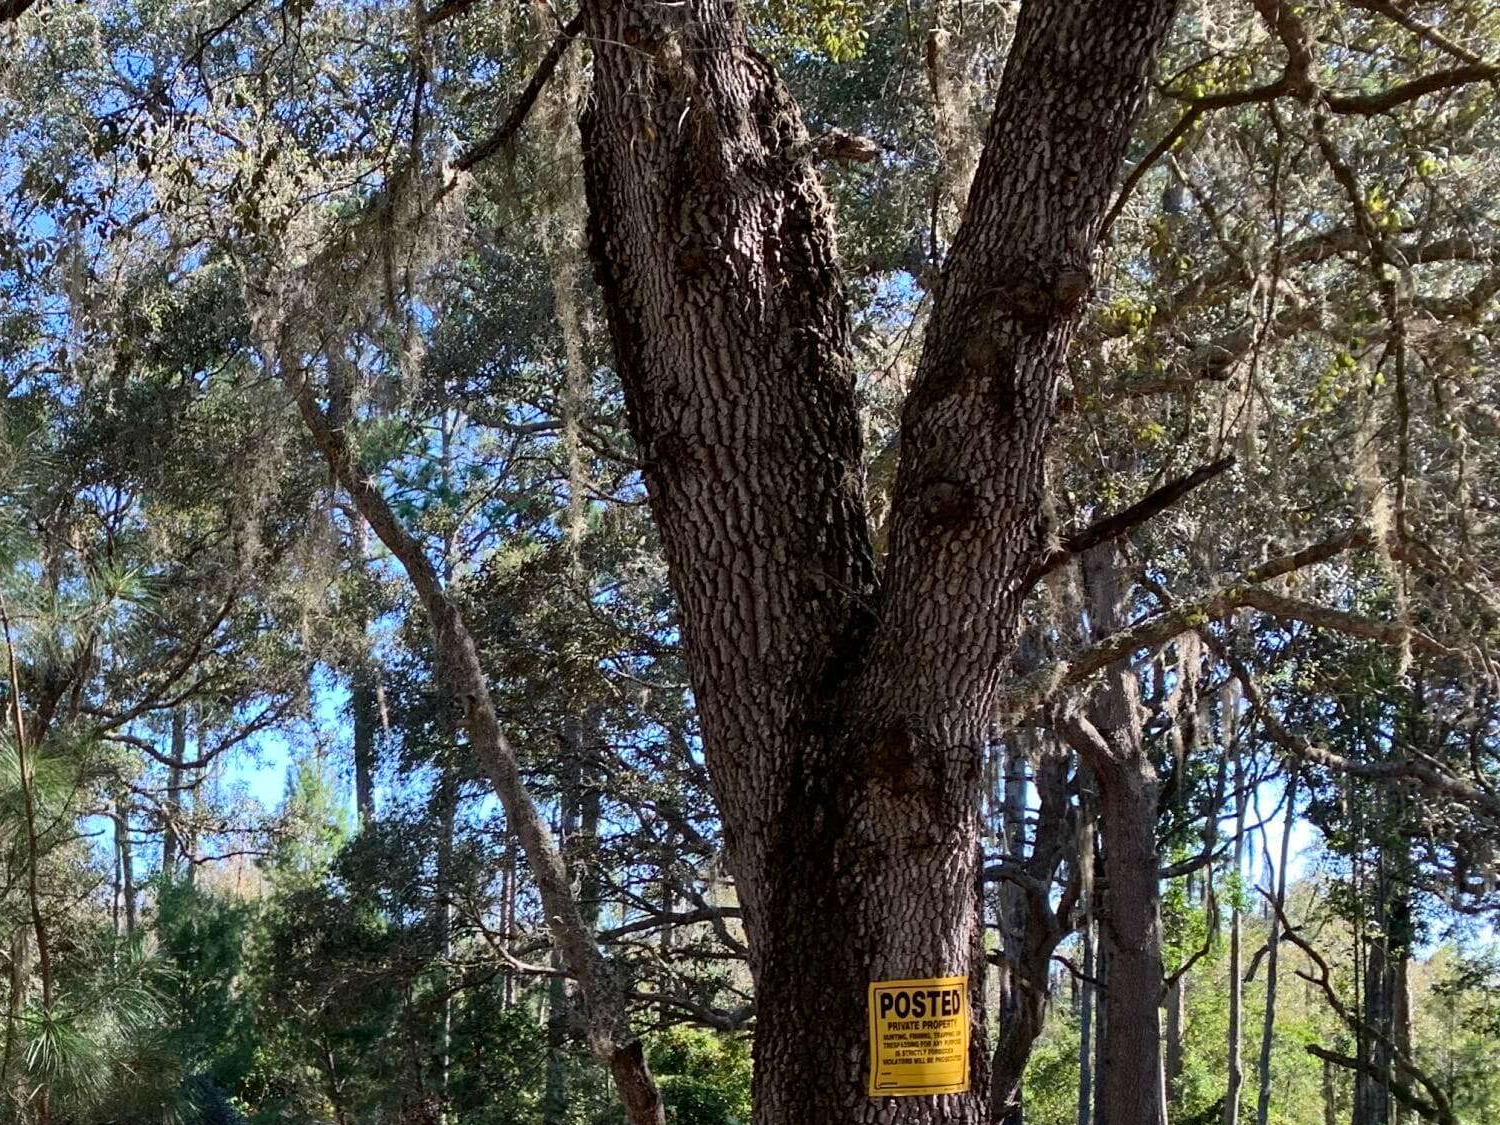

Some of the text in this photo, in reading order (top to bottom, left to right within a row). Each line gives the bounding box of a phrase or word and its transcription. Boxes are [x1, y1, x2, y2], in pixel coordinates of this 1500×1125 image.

[880, 989, 961, 1019] POSTED
[887, 1019, 957, 1031] PRIVATE PROPERTY
